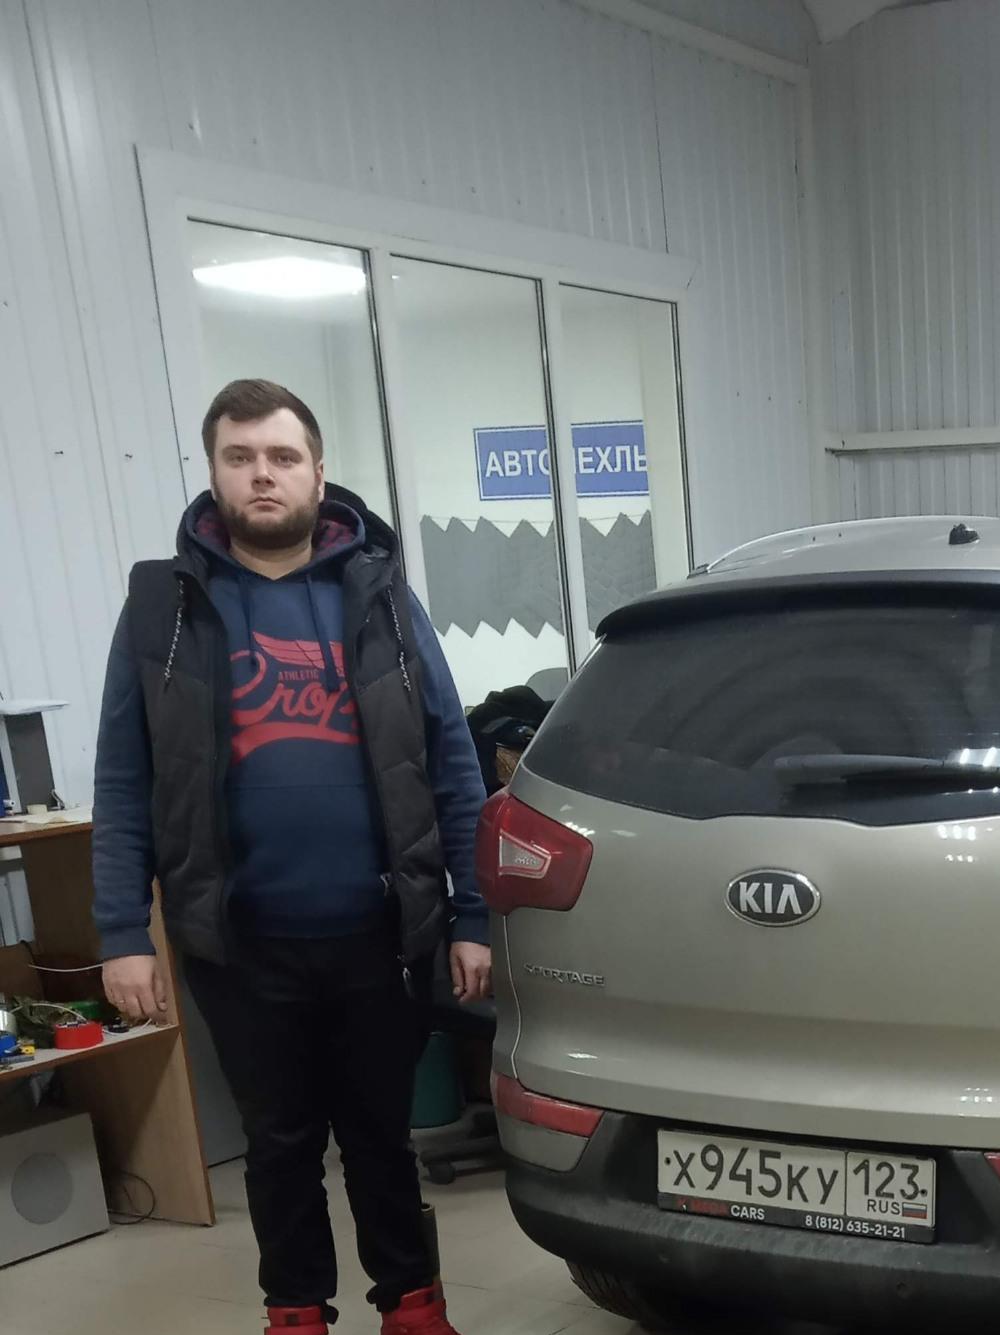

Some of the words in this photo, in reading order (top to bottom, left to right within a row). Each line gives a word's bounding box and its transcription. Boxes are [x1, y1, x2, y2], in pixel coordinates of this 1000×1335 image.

[278, 669, 320, 681] ATHLETIC
[739, 881, 802, 915] KIA
[523, 963, 605, 987] SPORTAGE
[672, 1143, 839, 1205] Х945КУ
[853, 1159, 921, 1200] 123
[730, 1204, 765, 1220] CARS
[866, 1199, 901, 1215] RUS
[805, 1214, 813, 1227] 8
[815, 1215, 844, 1232] (812)
[846, 1220, 905, 1238] 635-21-21
